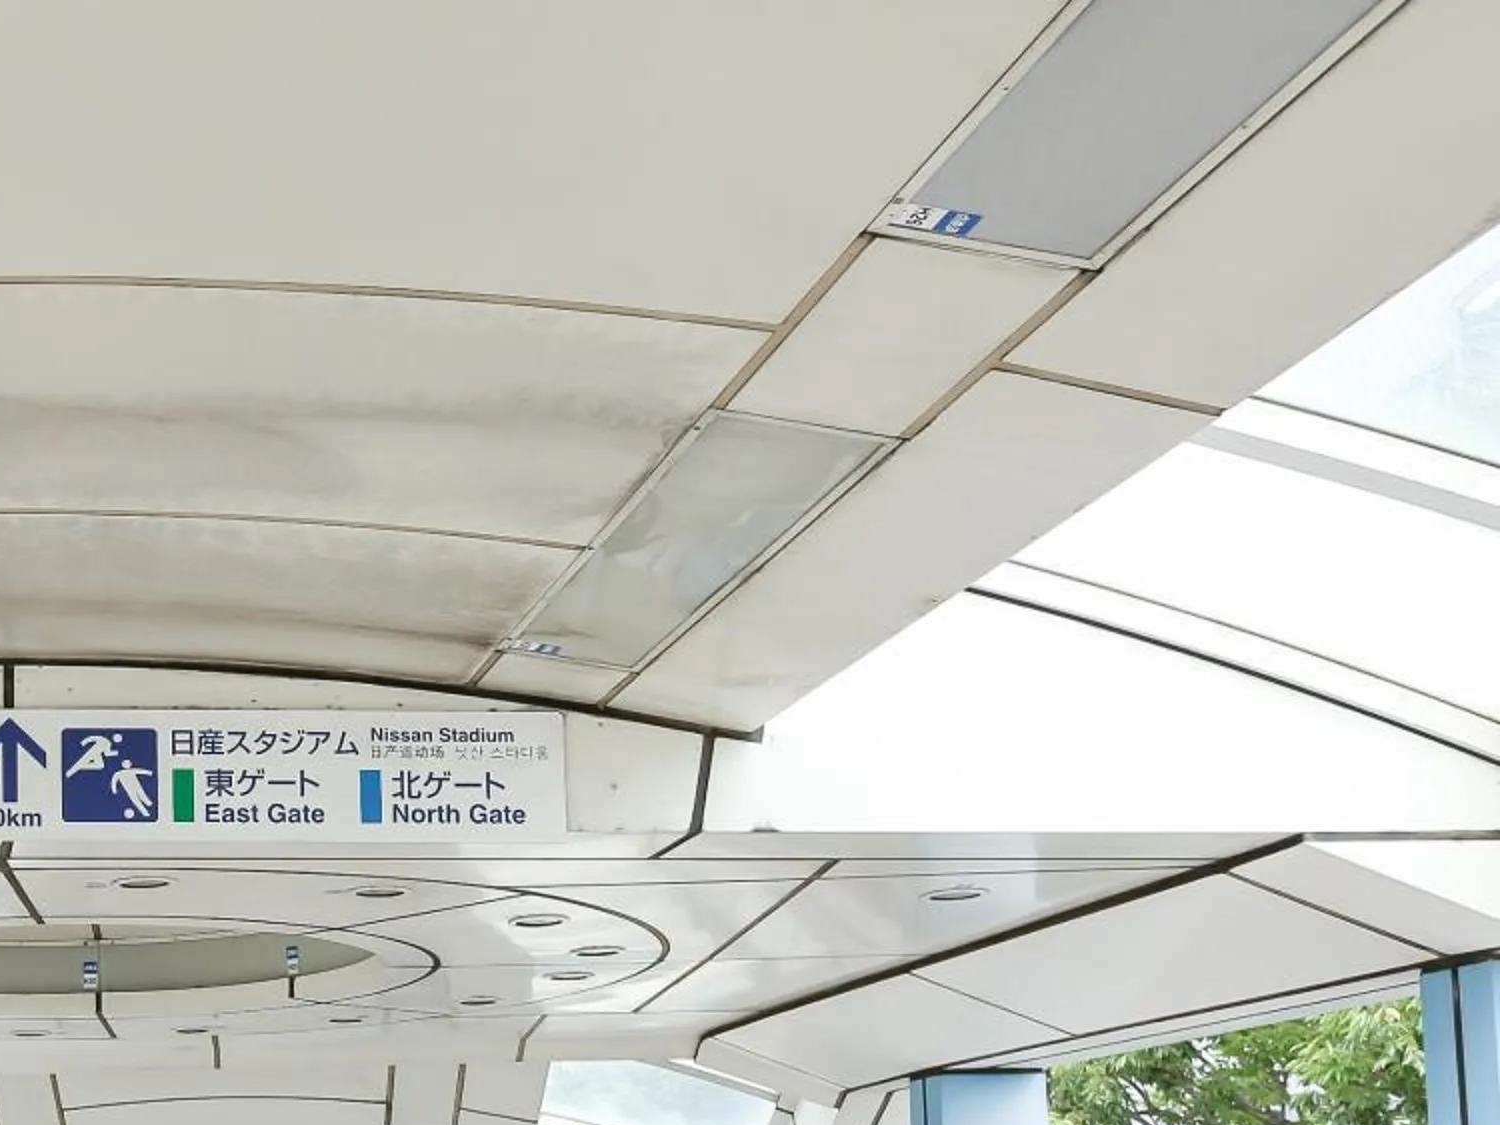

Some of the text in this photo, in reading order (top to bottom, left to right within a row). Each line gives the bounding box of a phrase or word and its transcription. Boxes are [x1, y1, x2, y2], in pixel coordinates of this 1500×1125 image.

[171, 728, 360, 756] 日産スタジアム
[370, 727, 515, 743] Nissan Stadium
[204, 768, 320, 797] 東ゲート
[391, 770, 506, 799] 北ゲート
[205, 803, 325, 824] East Gate
[392, 803, 526, 824] North Gate
